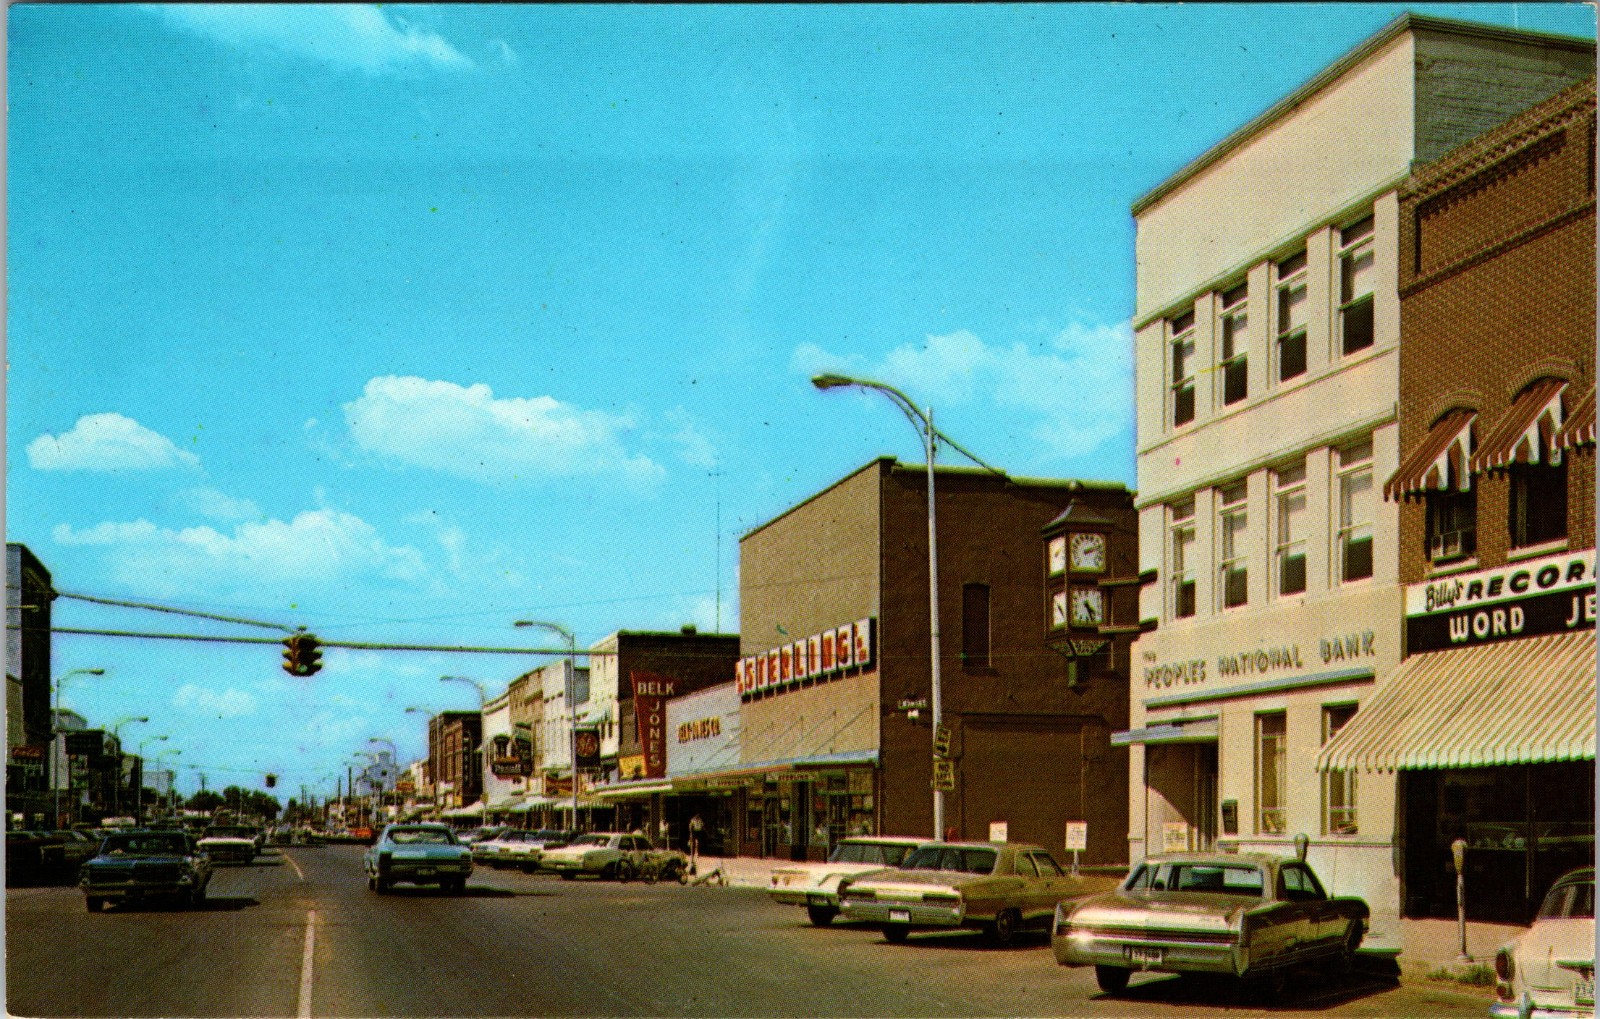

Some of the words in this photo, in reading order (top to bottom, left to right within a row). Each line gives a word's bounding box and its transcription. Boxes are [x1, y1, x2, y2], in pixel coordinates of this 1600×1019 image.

[1425, 578, 1463, 611] Billy's
[1466, 559, 1596, 601] RECOR
[1449, 606, 1525, 643] WORD
[744, 629, 850, 690] STERLING
[1143, 658, 1207, 690] PEOPLES
[1218, 644, 1304, 677] NATIONAL
[1318, 630, 1376, 664] BANK
[637, 681, 675, 696] BELK
[648, 700, 661, 767] JONES
